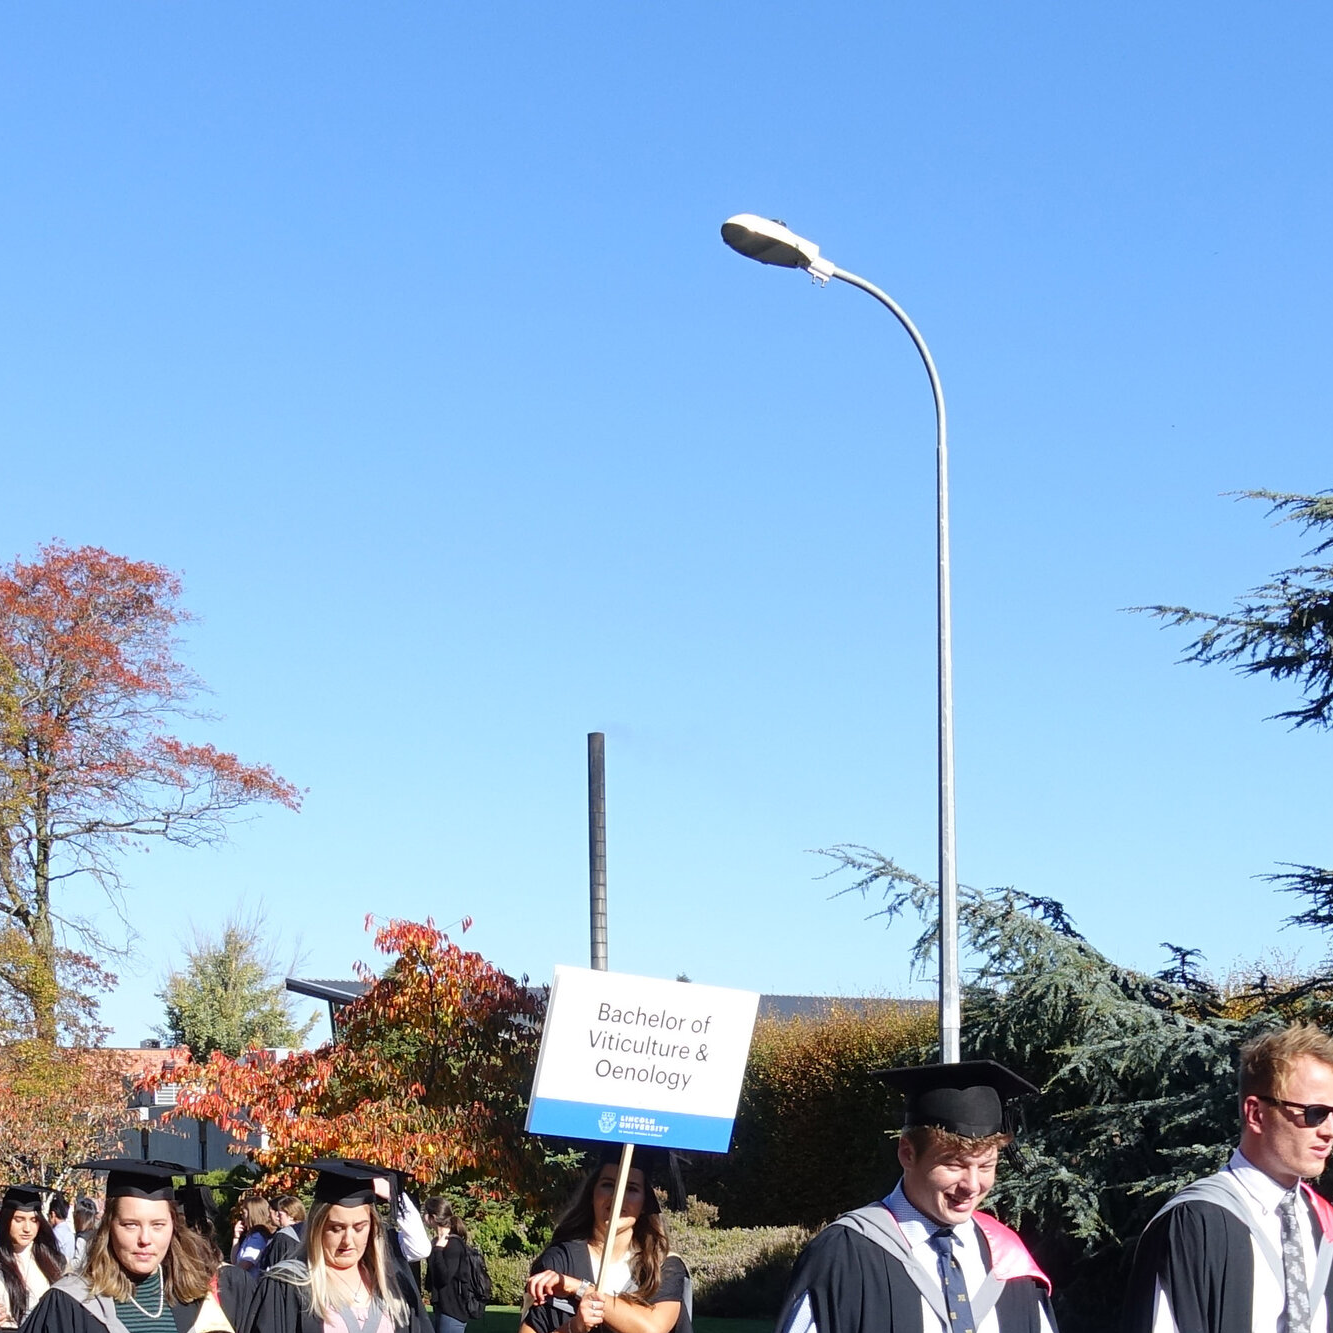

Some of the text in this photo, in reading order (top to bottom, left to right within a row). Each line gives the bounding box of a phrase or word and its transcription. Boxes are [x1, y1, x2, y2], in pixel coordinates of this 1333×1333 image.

[597, 1002, 712, 1034] Bachelor of
[589, 1029, 709, 1062] Viticulture &
[595, 1059, 692, 1091] Oenology
[619, 1121, 669, 1133] UNIVERSITY
[620, 1115, 656, 1125] LINCOLN
